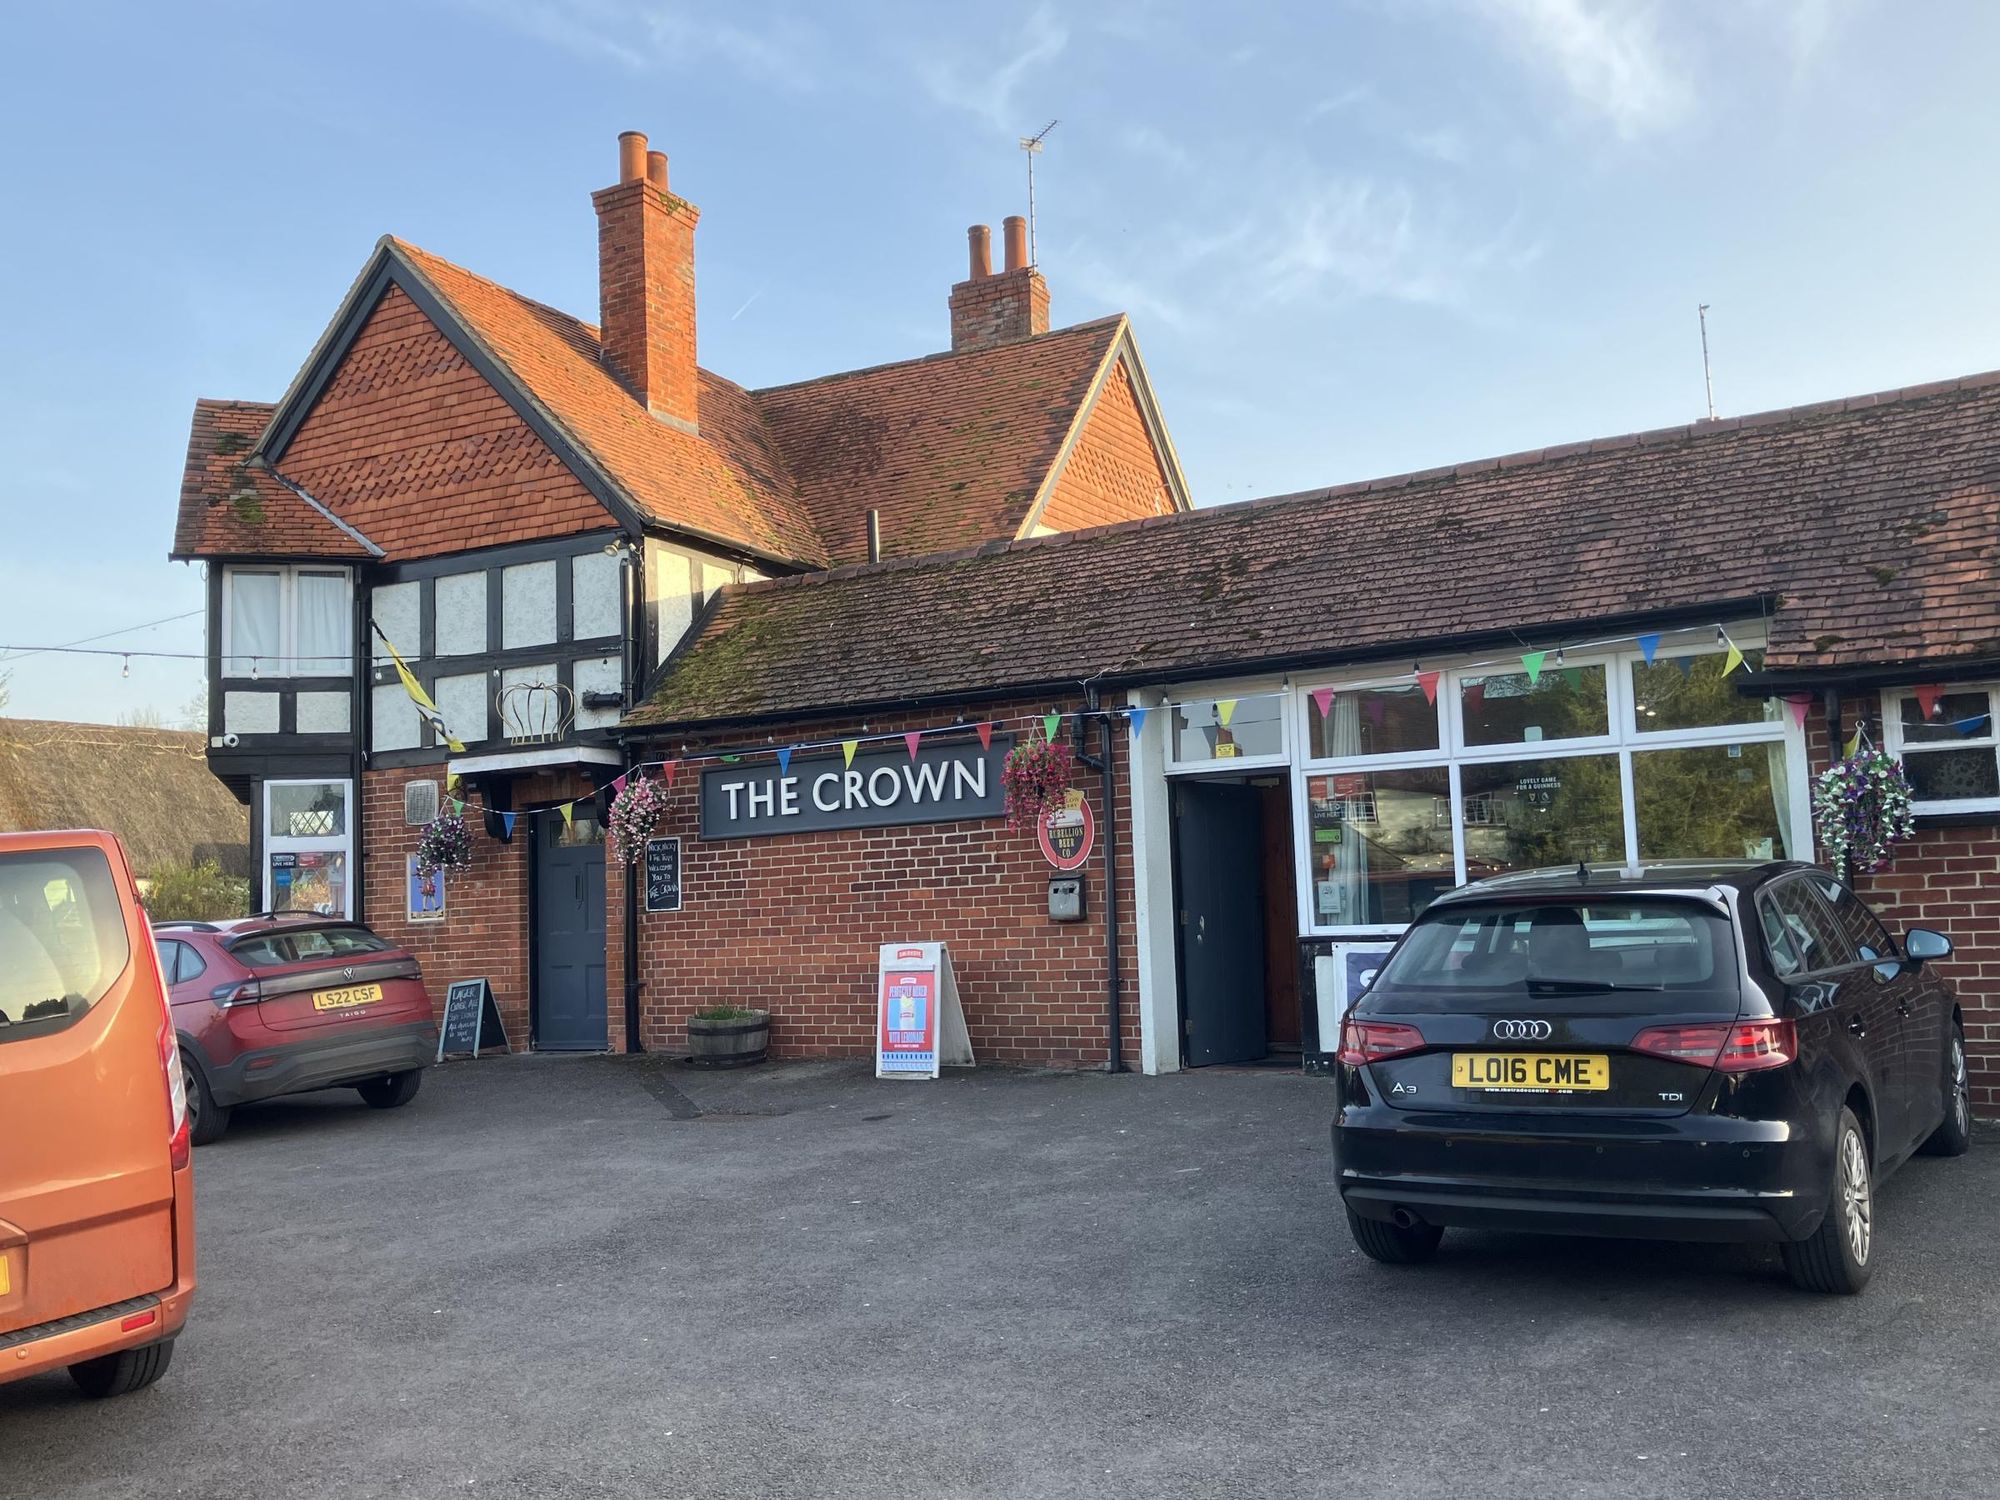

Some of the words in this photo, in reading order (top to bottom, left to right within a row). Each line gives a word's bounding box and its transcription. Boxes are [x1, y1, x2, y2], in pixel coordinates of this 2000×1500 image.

[721, 776, 800, 820] THE
[812, 757, 986, 812] CROWN
[1533, 782, 1561, 790] GUINNESS
[1049, 827, 1083, 839] REBELLION
[1058, 838, 1075, 848] BEER
[317, 990, 352, 1007] LS22
[352, 986, 375, 1001] CSF
[340, 1010, 367, 1018] TAIGO
[1469, 1057, 1527, 1083] LO16
[1536, 1058, 1591, 1084] CME
[1392, 1082, 1417, 1094] A3
[1658, 1092, 1683, 1101] TDI
